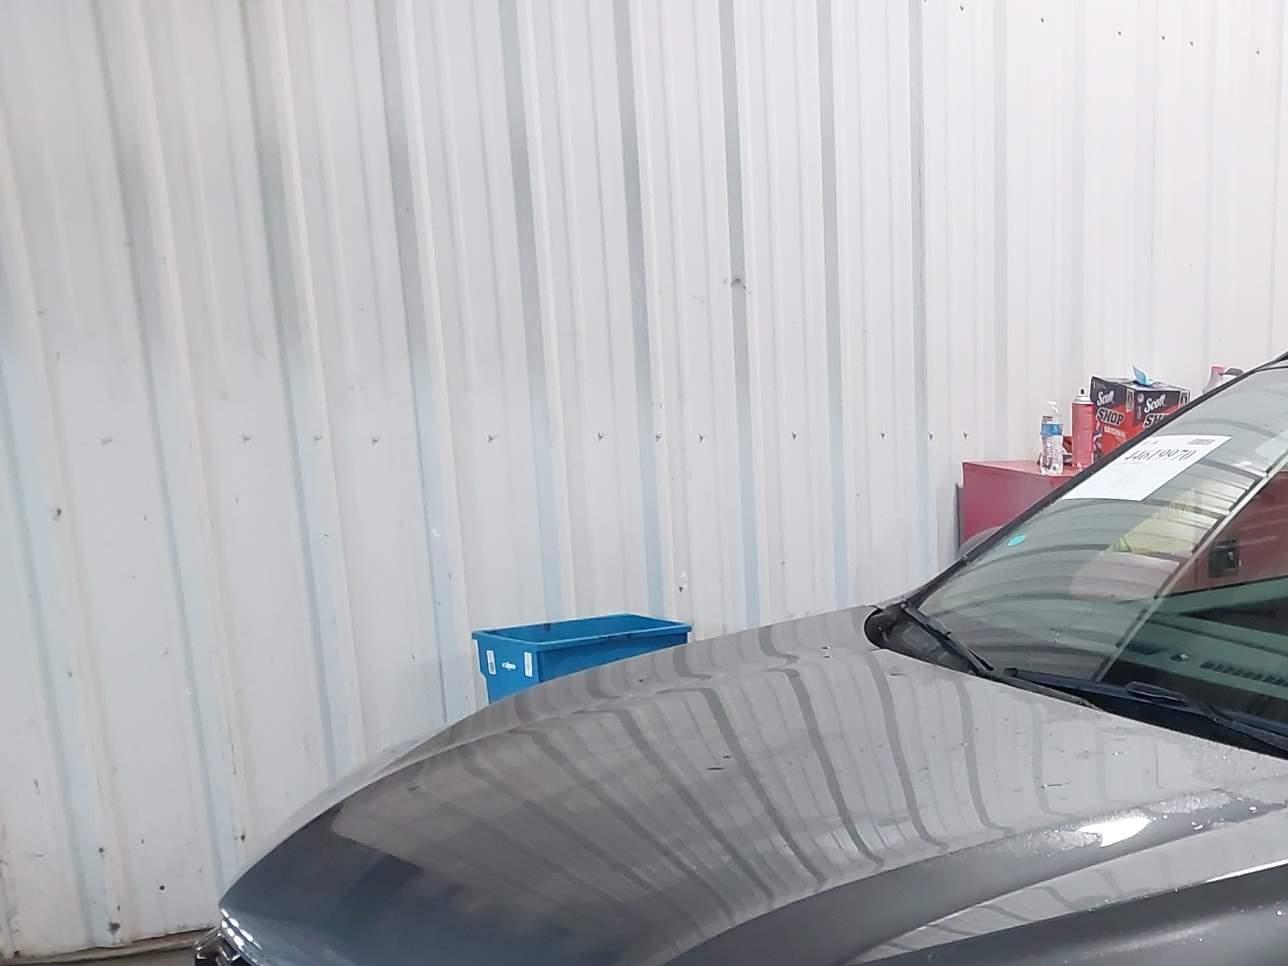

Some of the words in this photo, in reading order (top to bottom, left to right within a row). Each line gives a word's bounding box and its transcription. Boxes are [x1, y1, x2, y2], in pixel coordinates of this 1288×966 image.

[1096, 390, 1115, 406] Scott
[1144, 393, 1167, 413] Scott
[1096, 407, 1124, 427] SHOP
